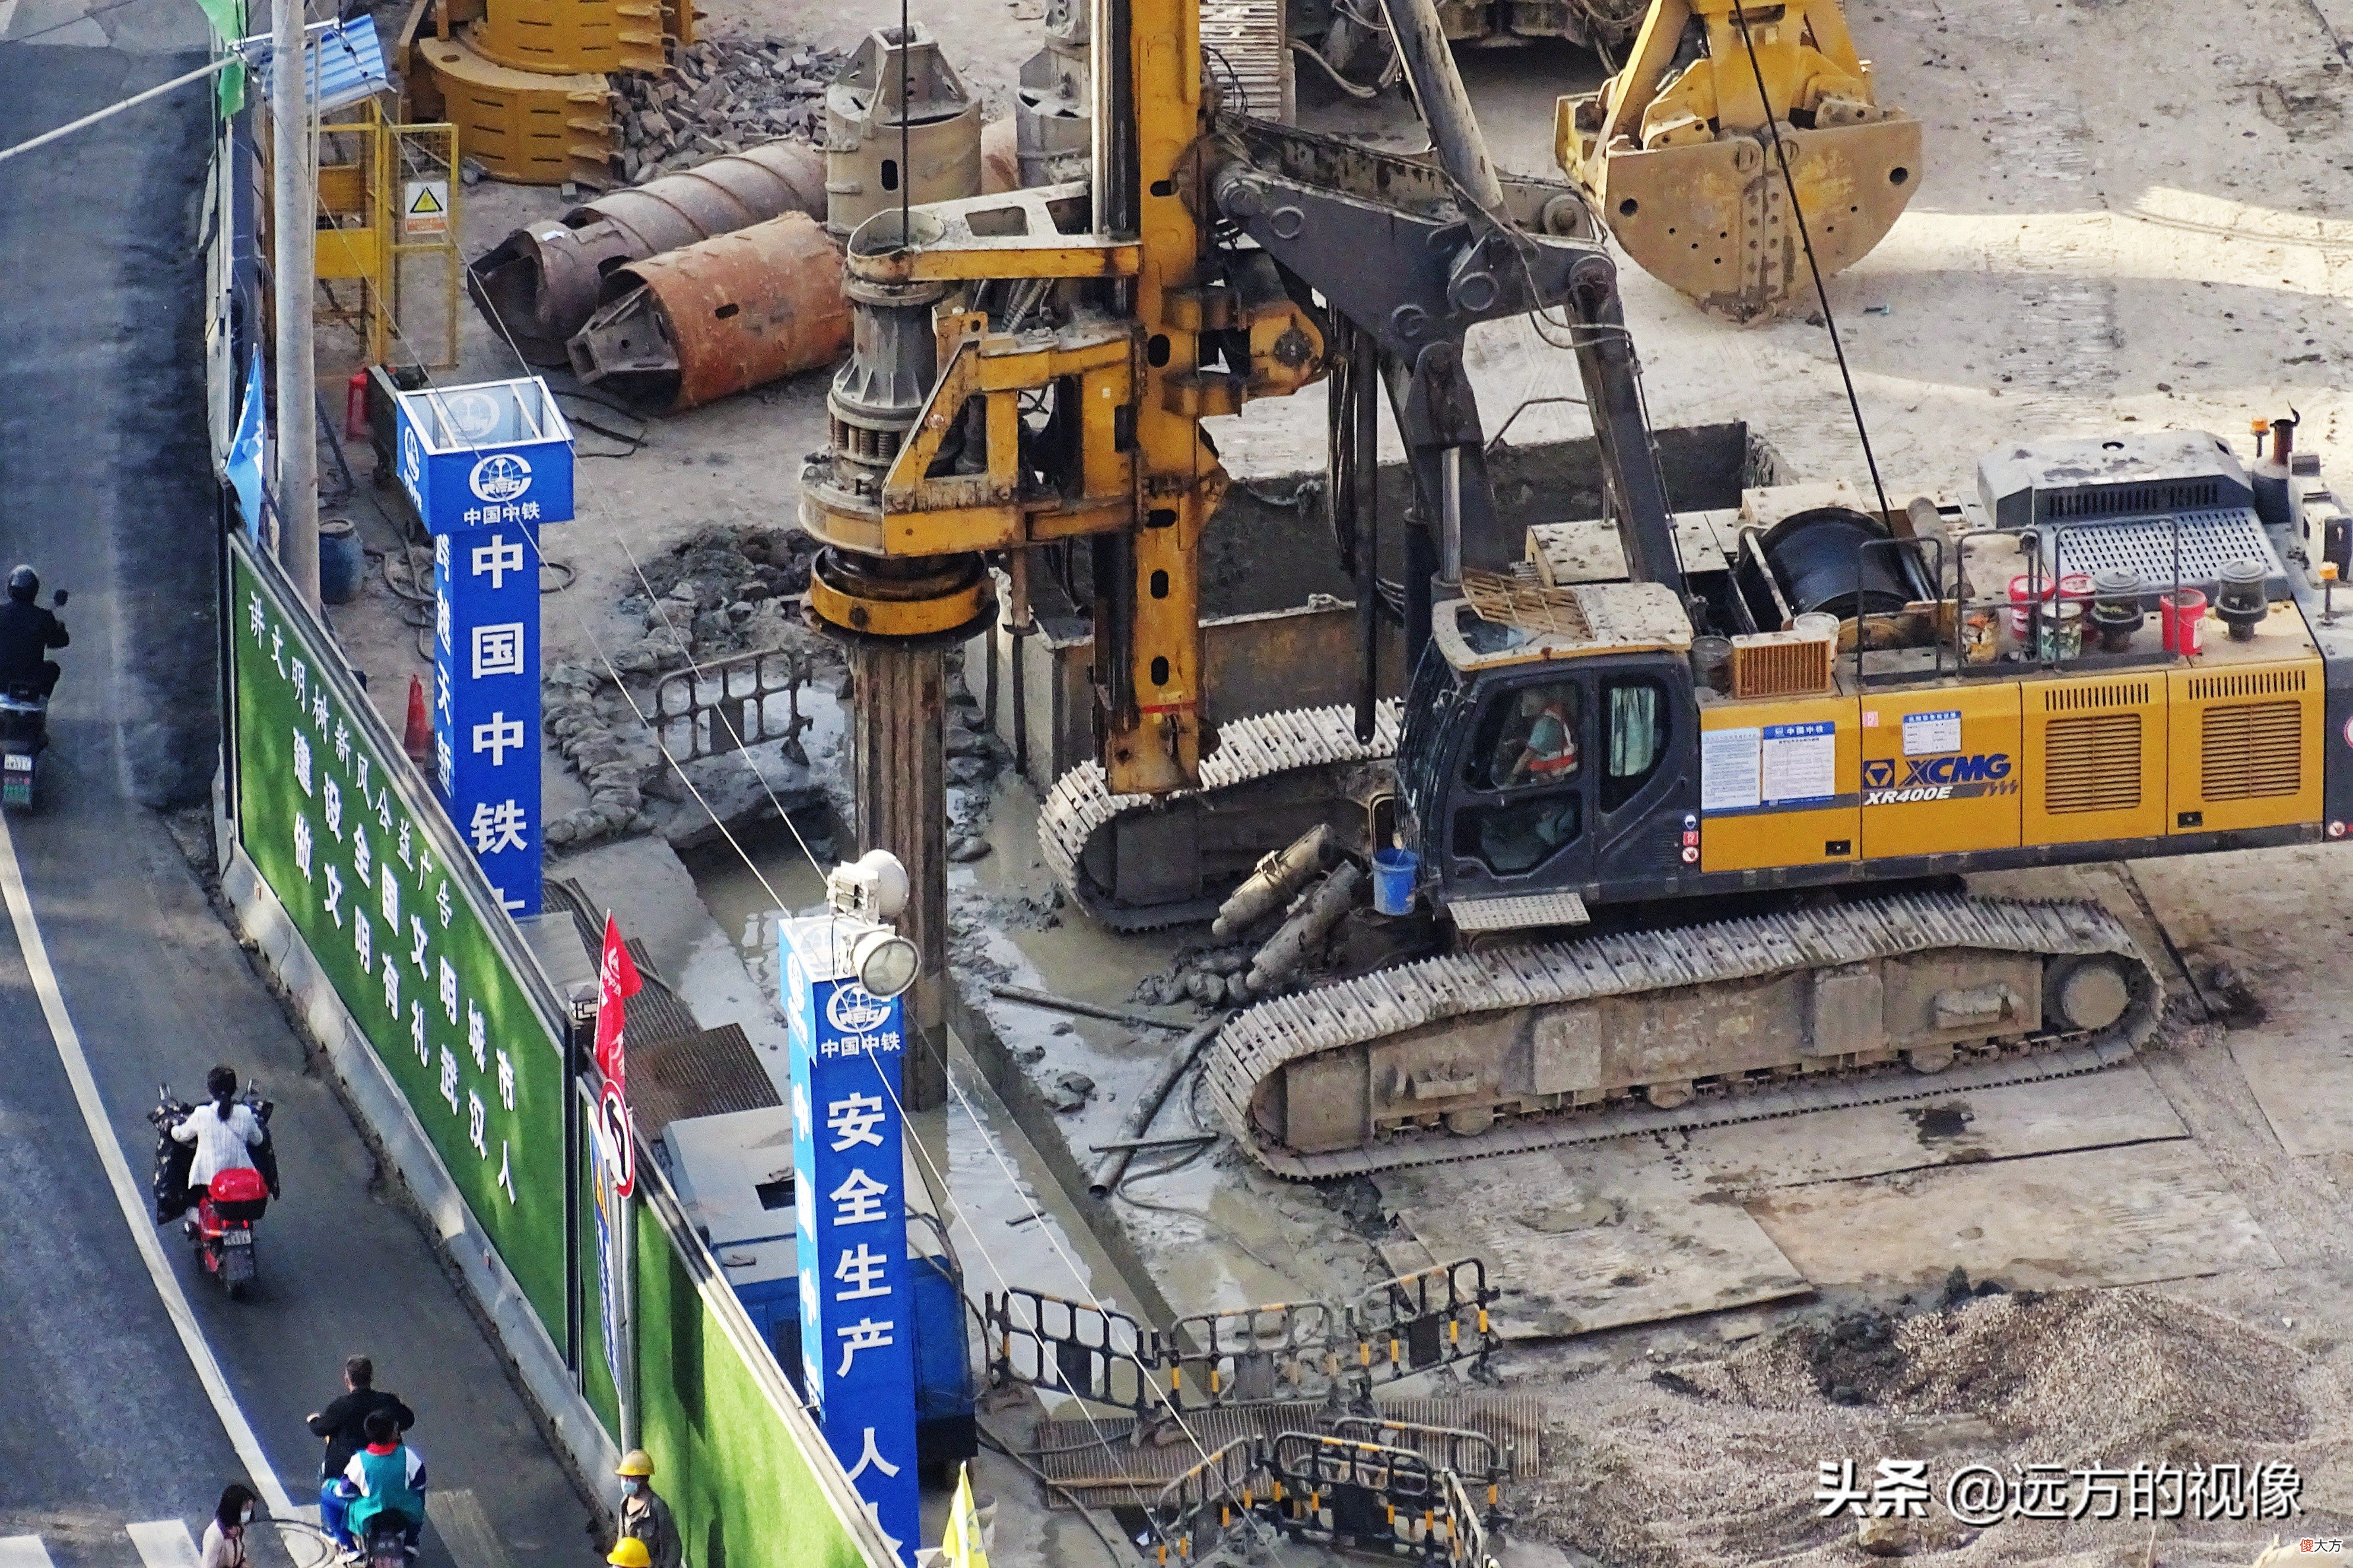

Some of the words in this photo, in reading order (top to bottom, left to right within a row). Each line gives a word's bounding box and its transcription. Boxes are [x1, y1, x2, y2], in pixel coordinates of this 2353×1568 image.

[463, 500, 541, 526] 中国中铁
[248, 591, 452, 928] 讲文明树新风公益广告
[1863, 785, 1953, 806] XR400E
[1899, 753, 2011, 787] XCMG
[293, 727, 515, 1112] 建设全国文明城市
[293, 812, 516, 1205] 做文明有礼武汉人
[820, 1031, 901, 1059] 中国中铁
[827, 1092, 894, 1379] 安全生产
